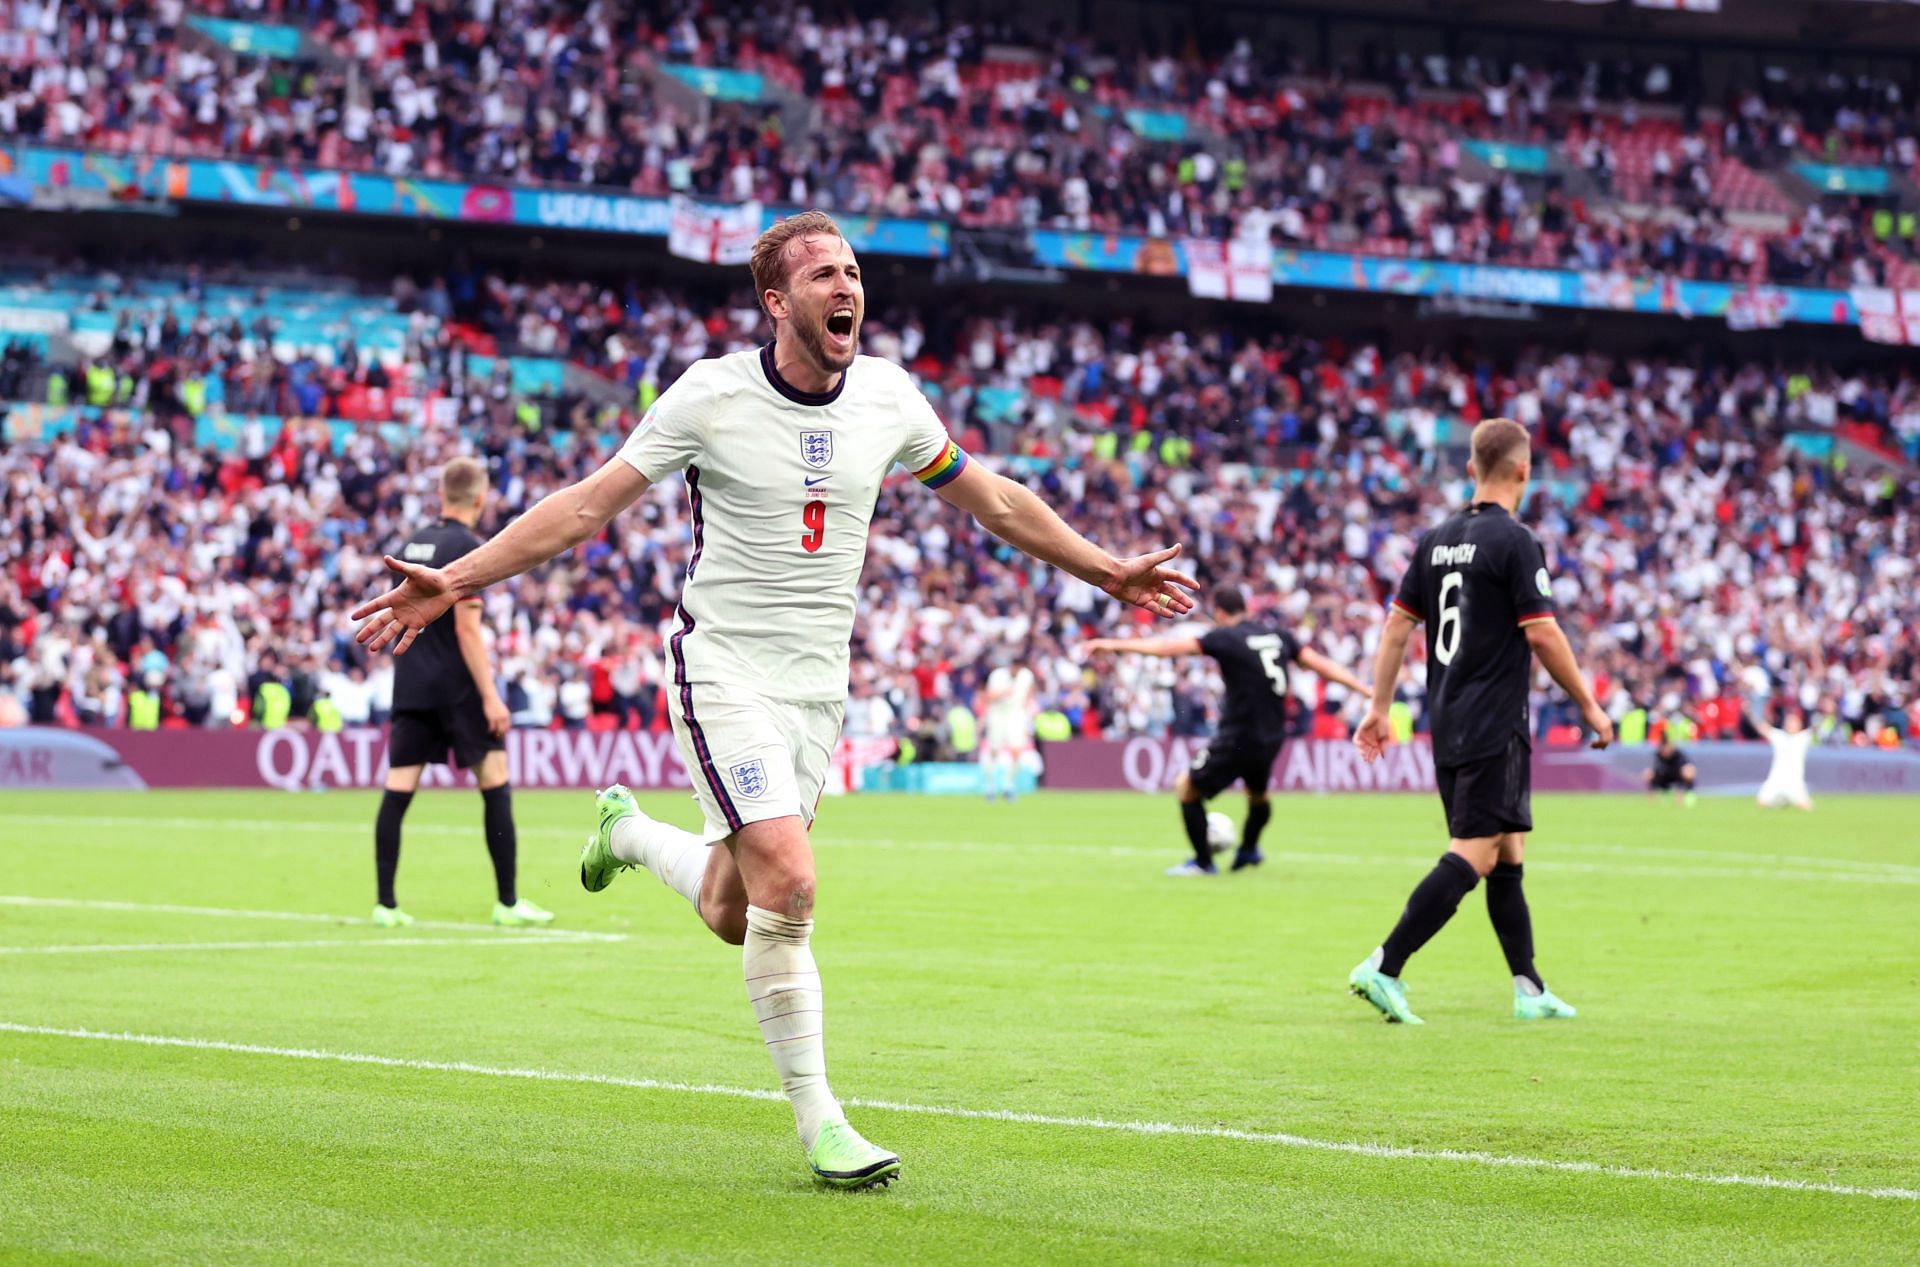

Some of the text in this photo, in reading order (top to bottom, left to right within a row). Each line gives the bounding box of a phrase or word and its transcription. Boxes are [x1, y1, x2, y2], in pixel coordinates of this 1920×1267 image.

[538, 193, 671, 235] UEFA EUR
[801, 500, 826, 553] 9
[1435, 571, 1463, 666] 6
[1258, 647, 1288, 697] 5
[0, 749, 53, 783] AR
[466, 728, 692, 787] IRWAYS
